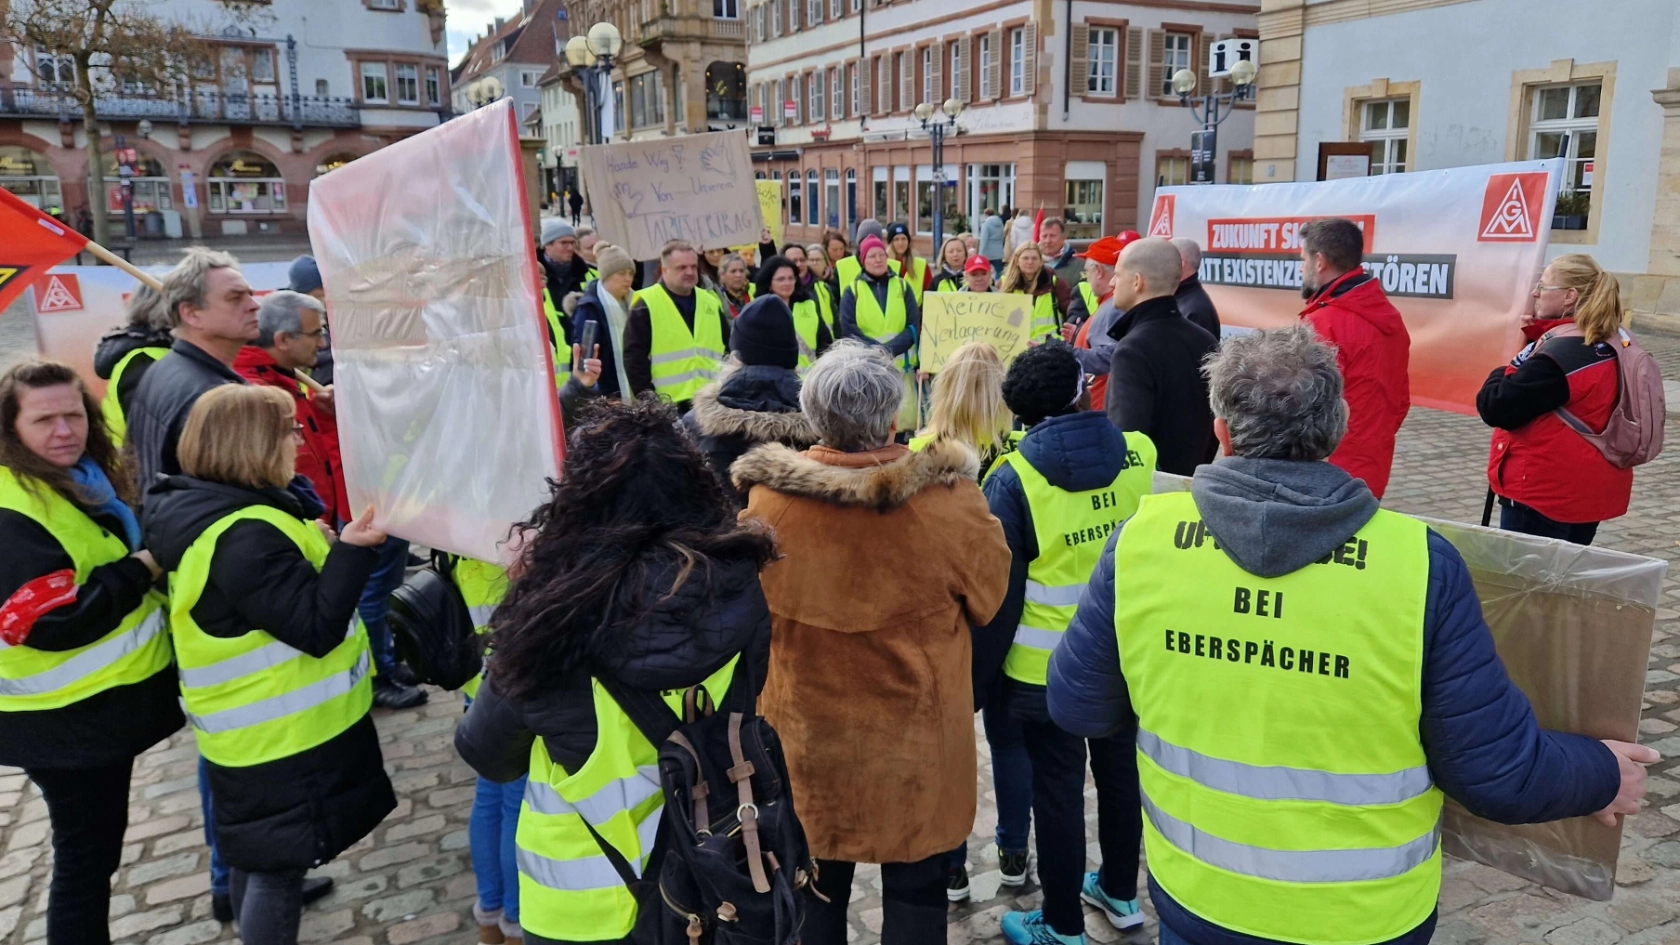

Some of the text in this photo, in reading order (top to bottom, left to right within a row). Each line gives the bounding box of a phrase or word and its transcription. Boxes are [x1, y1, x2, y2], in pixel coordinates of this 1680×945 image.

[1211, 223, 1280, 249] ZUKUNFT
[1198, 257, 1304, 288] ATT EXISTENZE
[939, 295, 1005, 319] Keine
[923, 315, 1020, 353] Verlagerung
[1091, 491, 1117, 511] BEI
[1064, 518, 1123, 547] EBERSPÄ
[1233, 586, 1283, 619] BEI
[1164, 629, 1350, 679] EBERSPÄCHER
